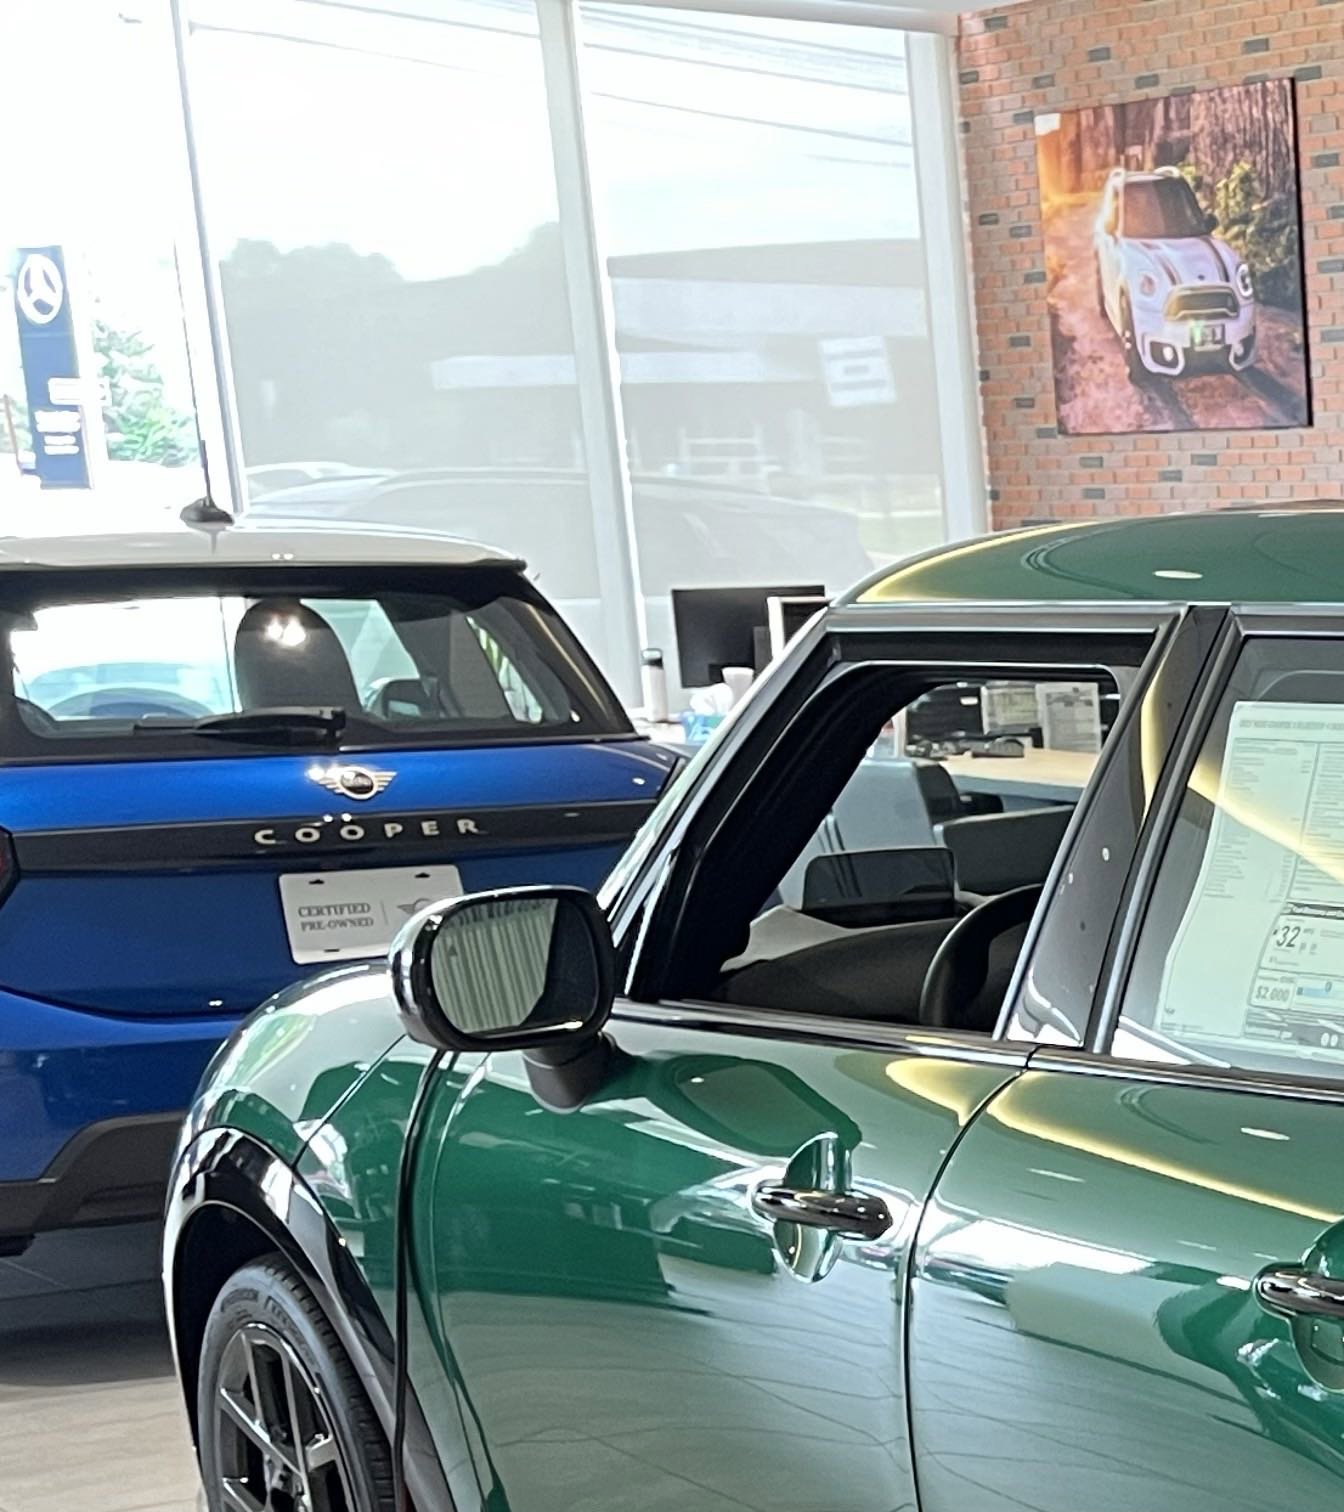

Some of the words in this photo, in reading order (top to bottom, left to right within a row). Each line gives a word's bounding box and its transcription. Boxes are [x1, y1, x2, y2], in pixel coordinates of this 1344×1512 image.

[254, 818, 479, 845] COOPER
[298, 902, 371, 918] CERTIFIED
[301, 917, 374, 932] PRE-OWNED
[1276, 925, 1301, 948] 32
